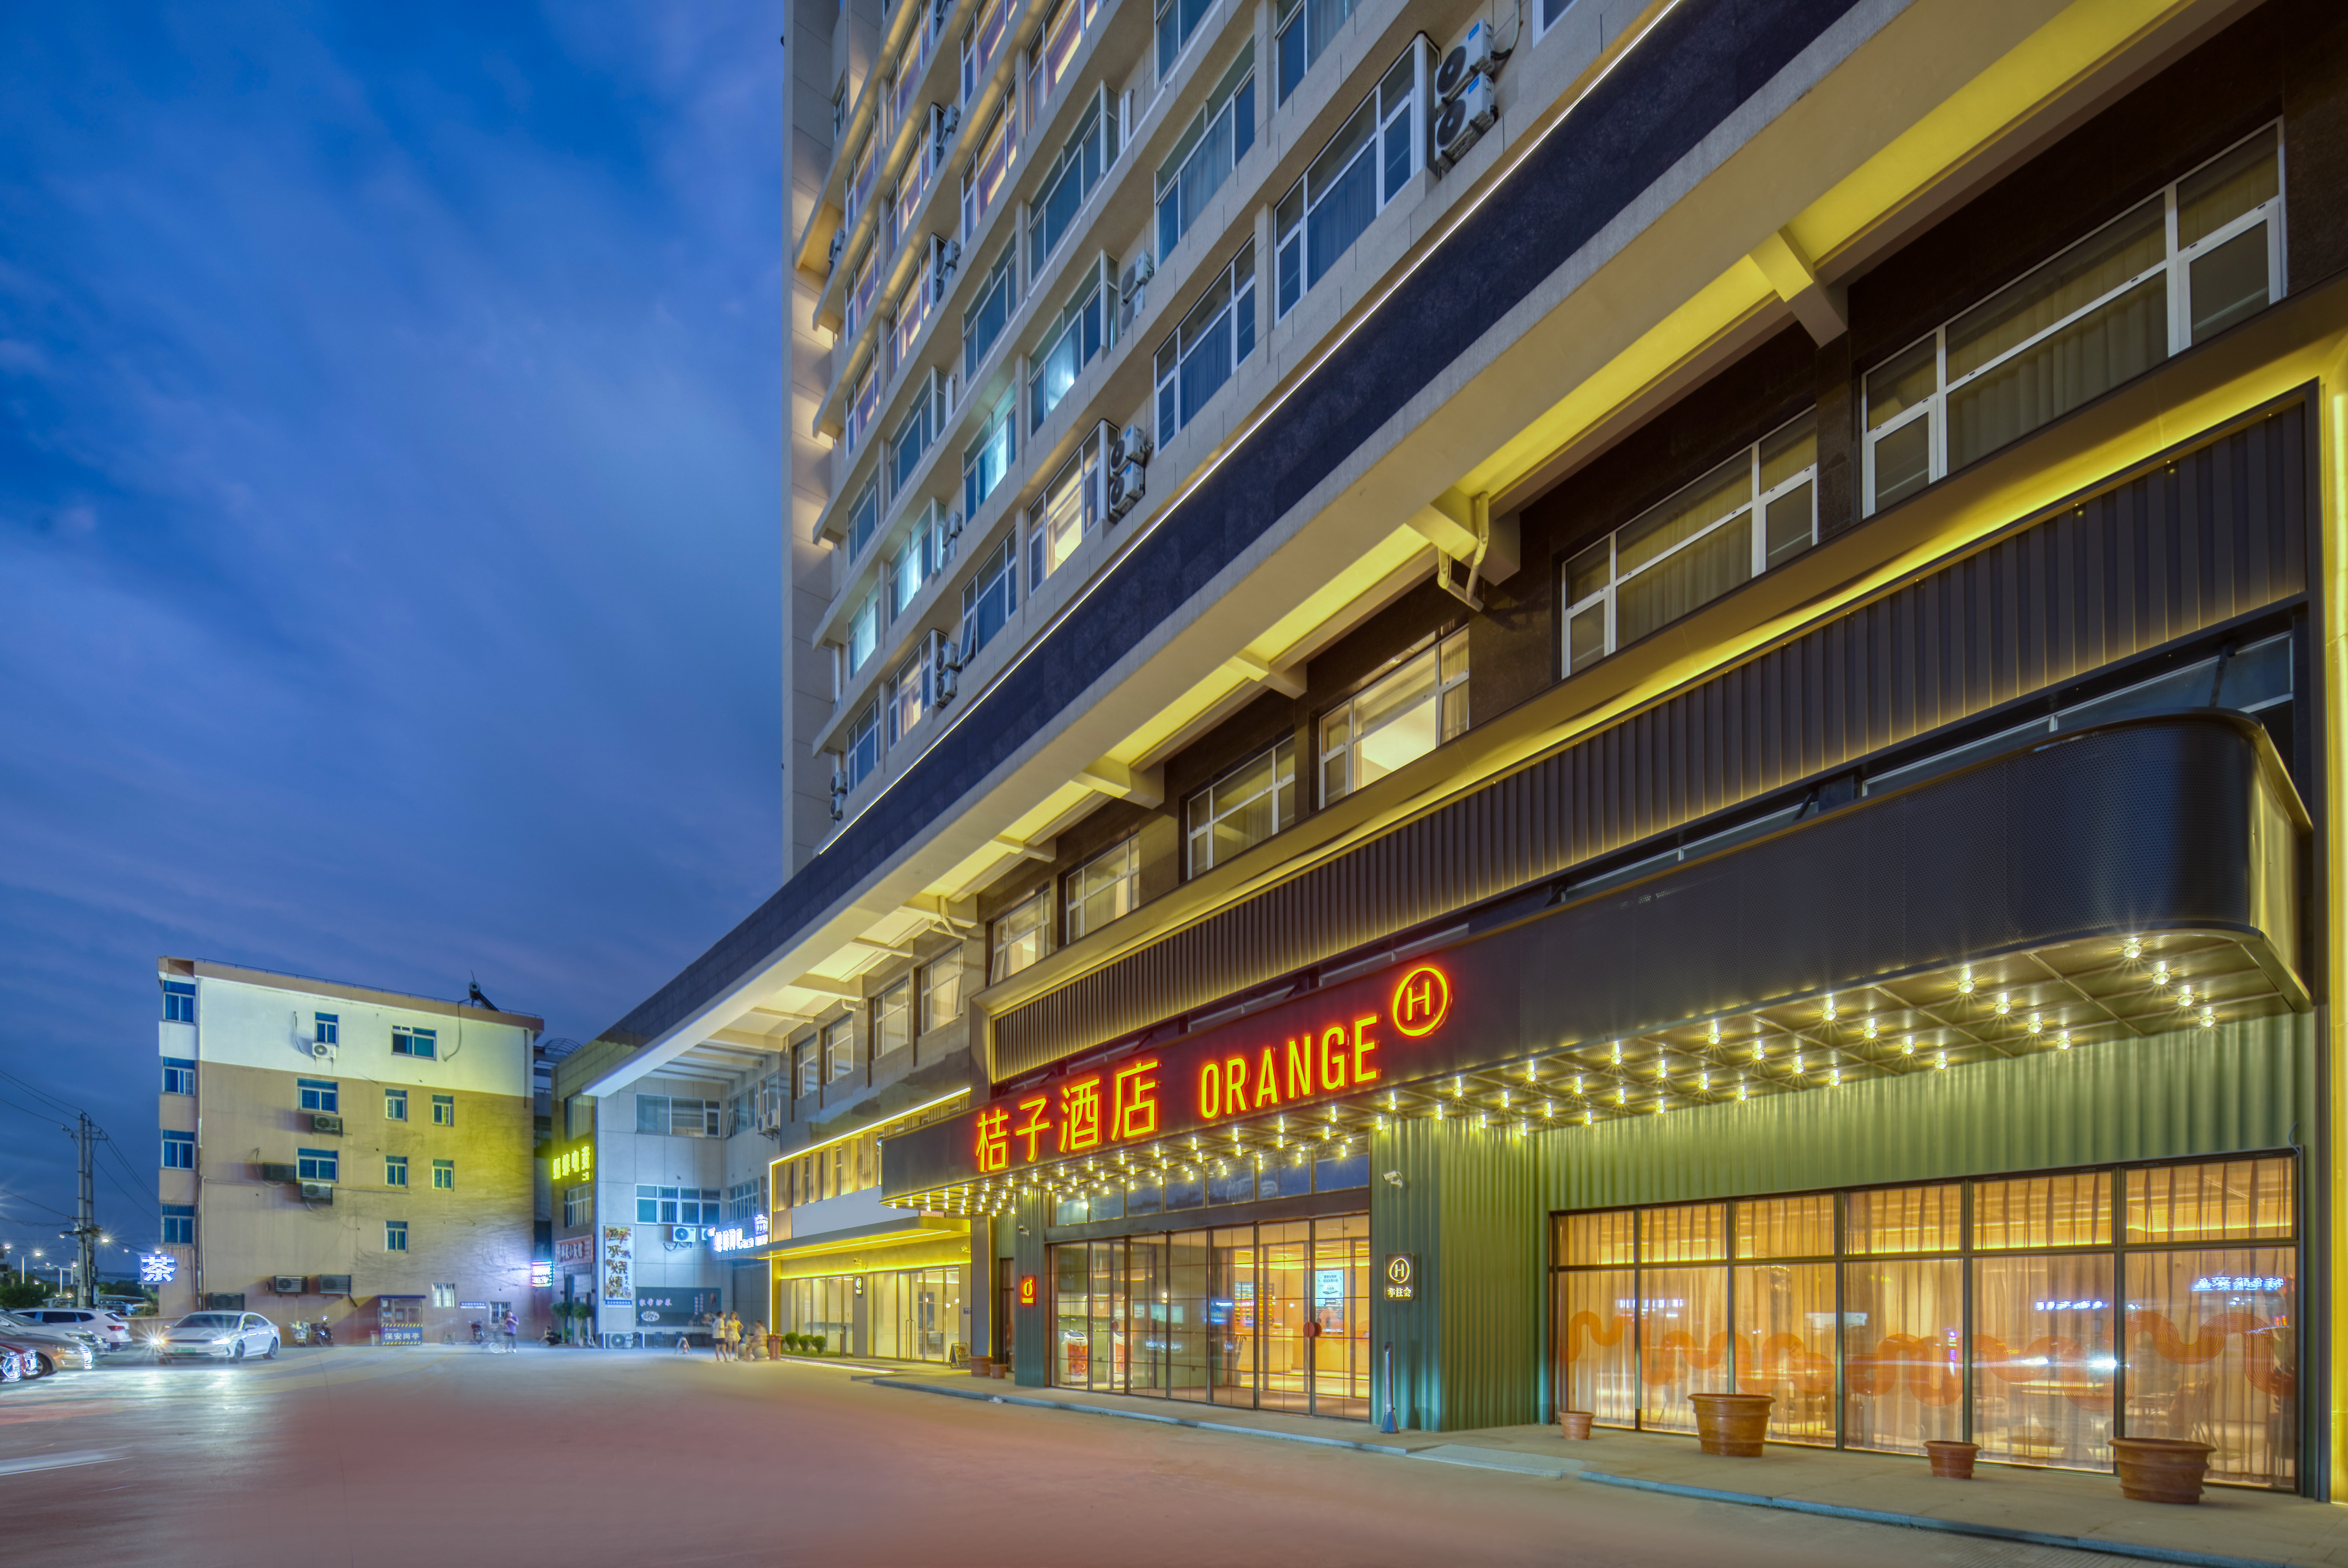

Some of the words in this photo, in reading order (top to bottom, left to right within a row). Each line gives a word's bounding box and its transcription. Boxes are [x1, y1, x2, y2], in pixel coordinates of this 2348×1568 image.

[1201, 1015, 1377, 1119] ORANGE
[976, 1061, 1158, 1172] 桔子酒店
[141, 1255, 176, 1282] 茶
[1387, 1287, 1411, 1298] 华住会
